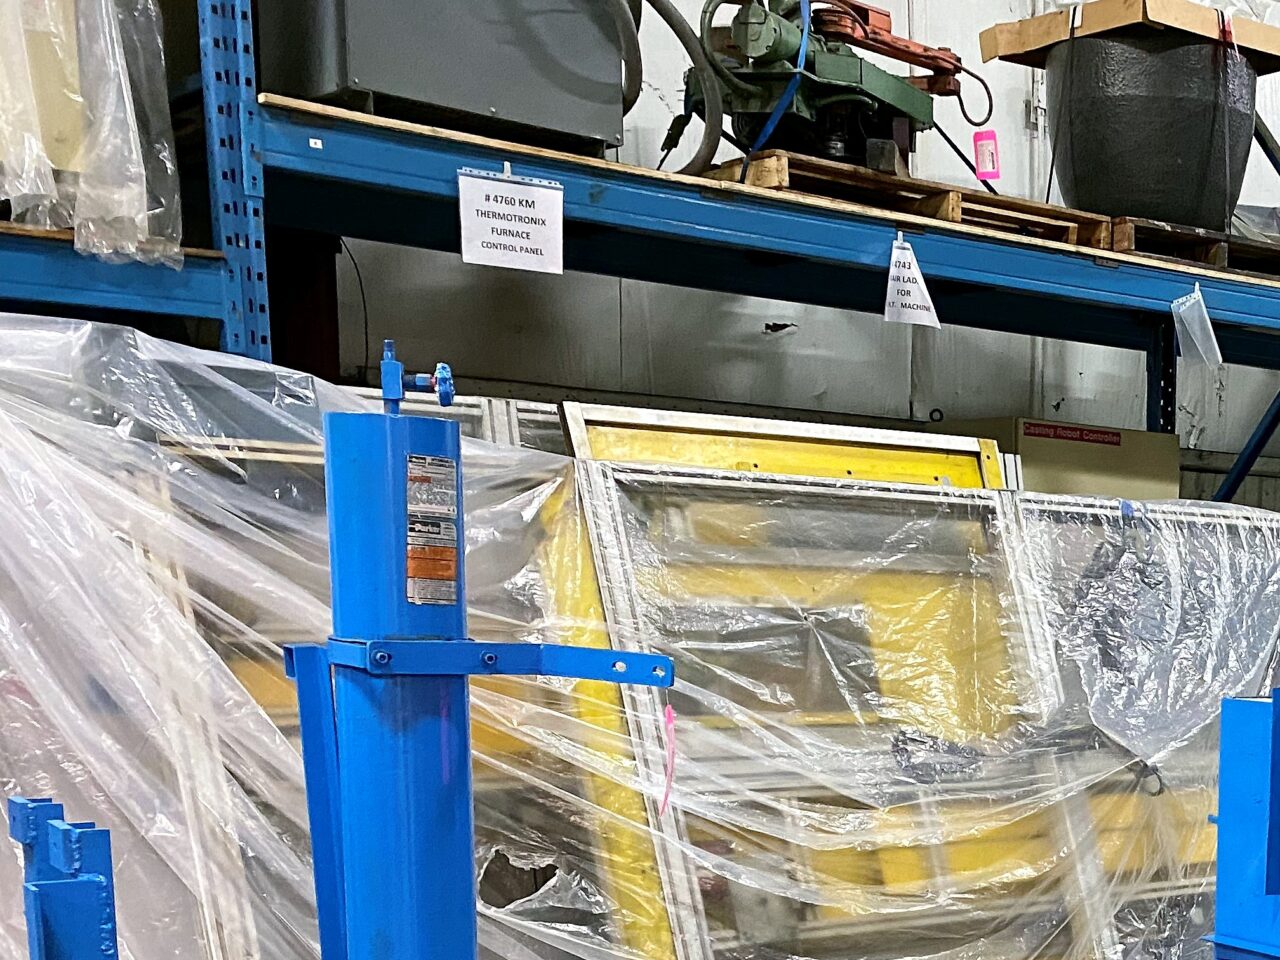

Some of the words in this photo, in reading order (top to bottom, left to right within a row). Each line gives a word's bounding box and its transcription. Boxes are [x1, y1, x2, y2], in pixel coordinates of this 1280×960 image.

[484, 193, 491, 203] #
[492, 194, 516, 206] 4760
[518, 198, 536, 209] KM
[475, 208, 547, 226] THERMOTRONIX
[491, 226, 531, 240] FURNACE
[481, 240, 518, 253] CONTROL
[519, 246, 544, 256] PANEL
[902, 276, 919, 285] LAD
[896, 288, 912, 297] FOR
[1023, 423, 1055, 438] Casting
[1056, 427, 1080, 438] Robot
[1082, 430, 1120, 443] Controller
